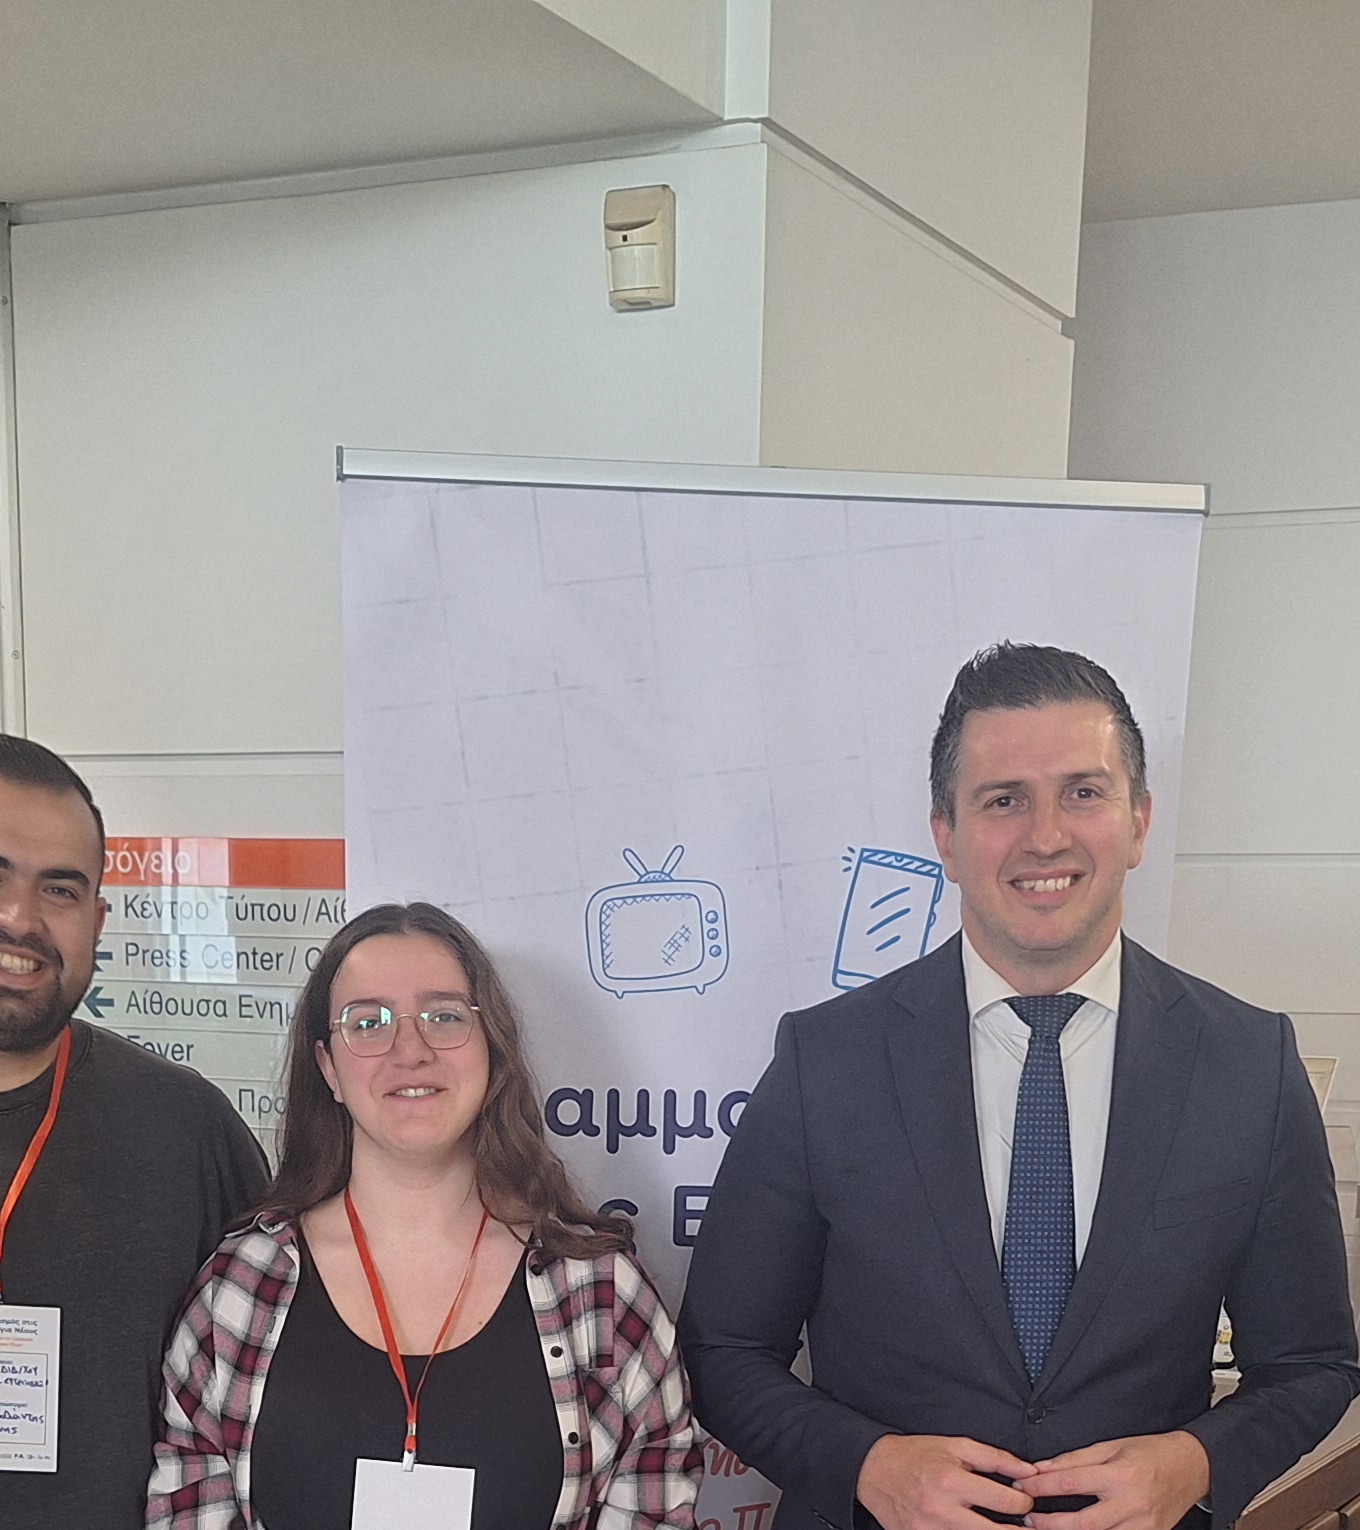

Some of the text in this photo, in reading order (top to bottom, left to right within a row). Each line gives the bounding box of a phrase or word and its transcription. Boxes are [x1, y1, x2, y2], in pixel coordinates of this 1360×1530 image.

[124, 893, 209, 926] Κέντρο
[219, 894, 297, 925] Τύπου
[125, 943, 191, 968] Press
[202, 944, 283, 971] Center
[125, 989, 228, 1018] Αίθουσα
[127, 1035, 194, 1062] oyer
